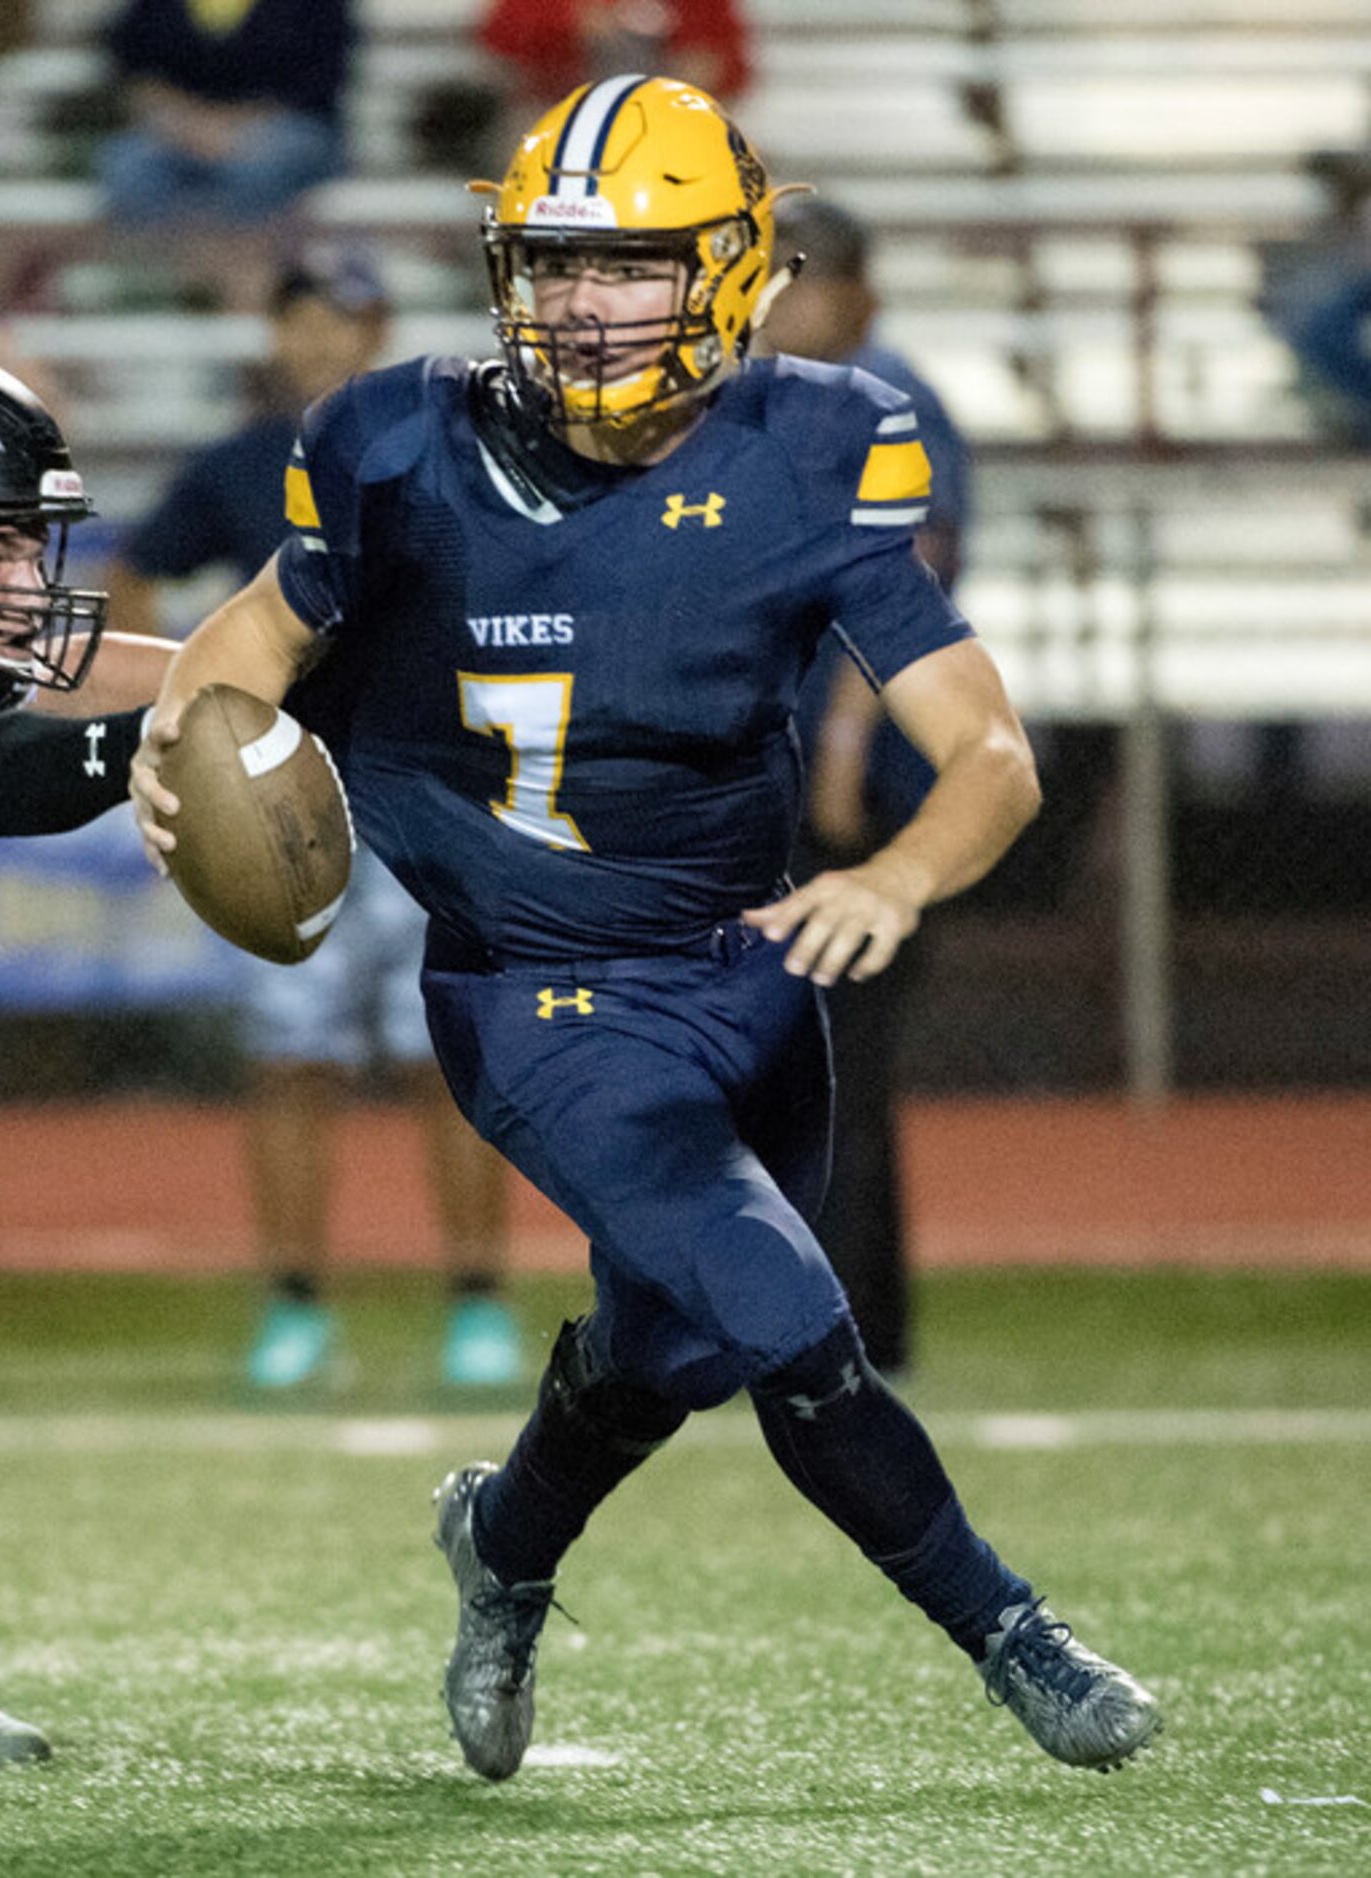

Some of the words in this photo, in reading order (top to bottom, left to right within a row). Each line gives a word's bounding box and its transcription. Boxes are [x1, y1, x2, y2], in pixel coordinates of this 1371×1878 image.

[536, 201, 603, 218] Ridde
[466, 613, 575, 647] VIKES
[456, 669, 592, 853] 7
